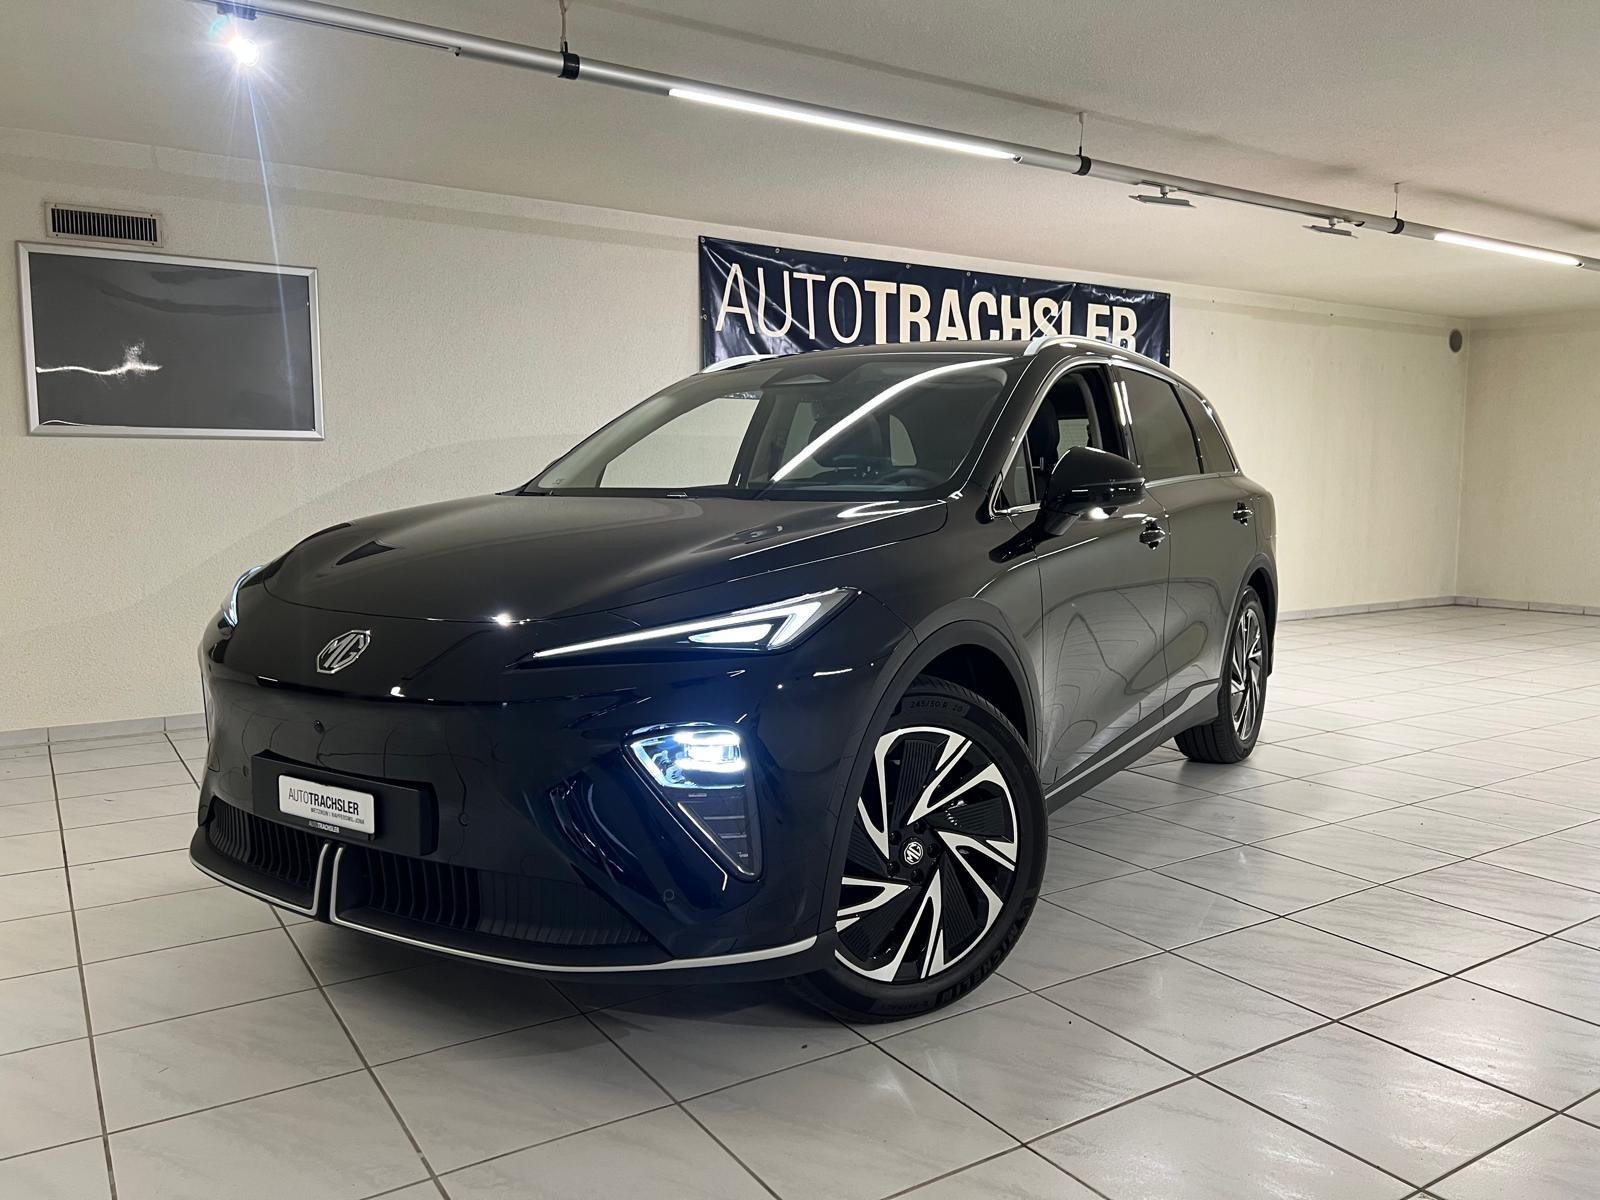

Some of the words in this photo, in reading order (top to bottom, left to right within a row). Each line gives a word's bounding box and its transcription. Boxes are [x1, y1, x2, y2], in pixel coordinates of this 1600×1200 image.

[715, 262, 1138, 352] AUTOTRACHSLER
[320, 633, 365, 669] MG
[288, 787, 359, 816] AUTOTRACHSLER
[905, 842, 922, 864] MG
